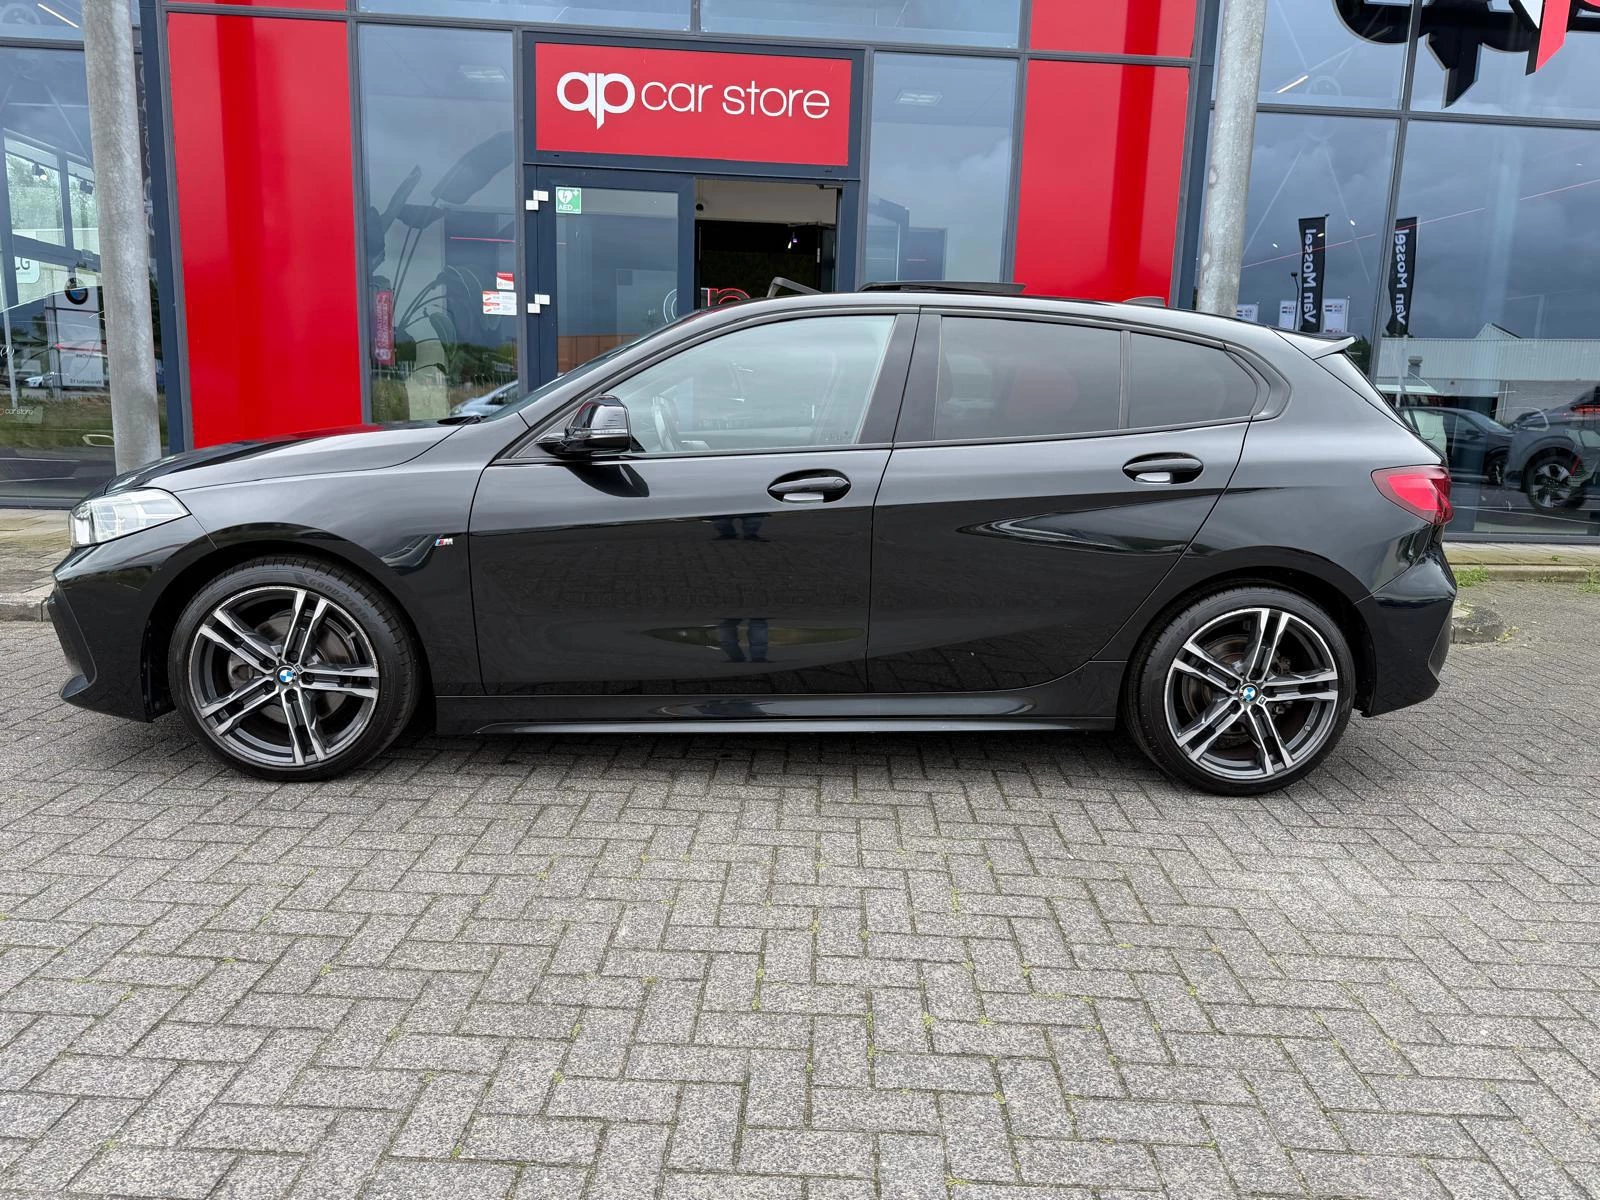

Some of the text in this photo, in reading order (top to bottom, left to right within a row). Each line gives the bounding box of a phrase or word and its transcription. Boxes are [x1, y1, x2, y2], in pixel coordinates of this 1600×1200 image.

[557, 71, 830, 130] ap car store
